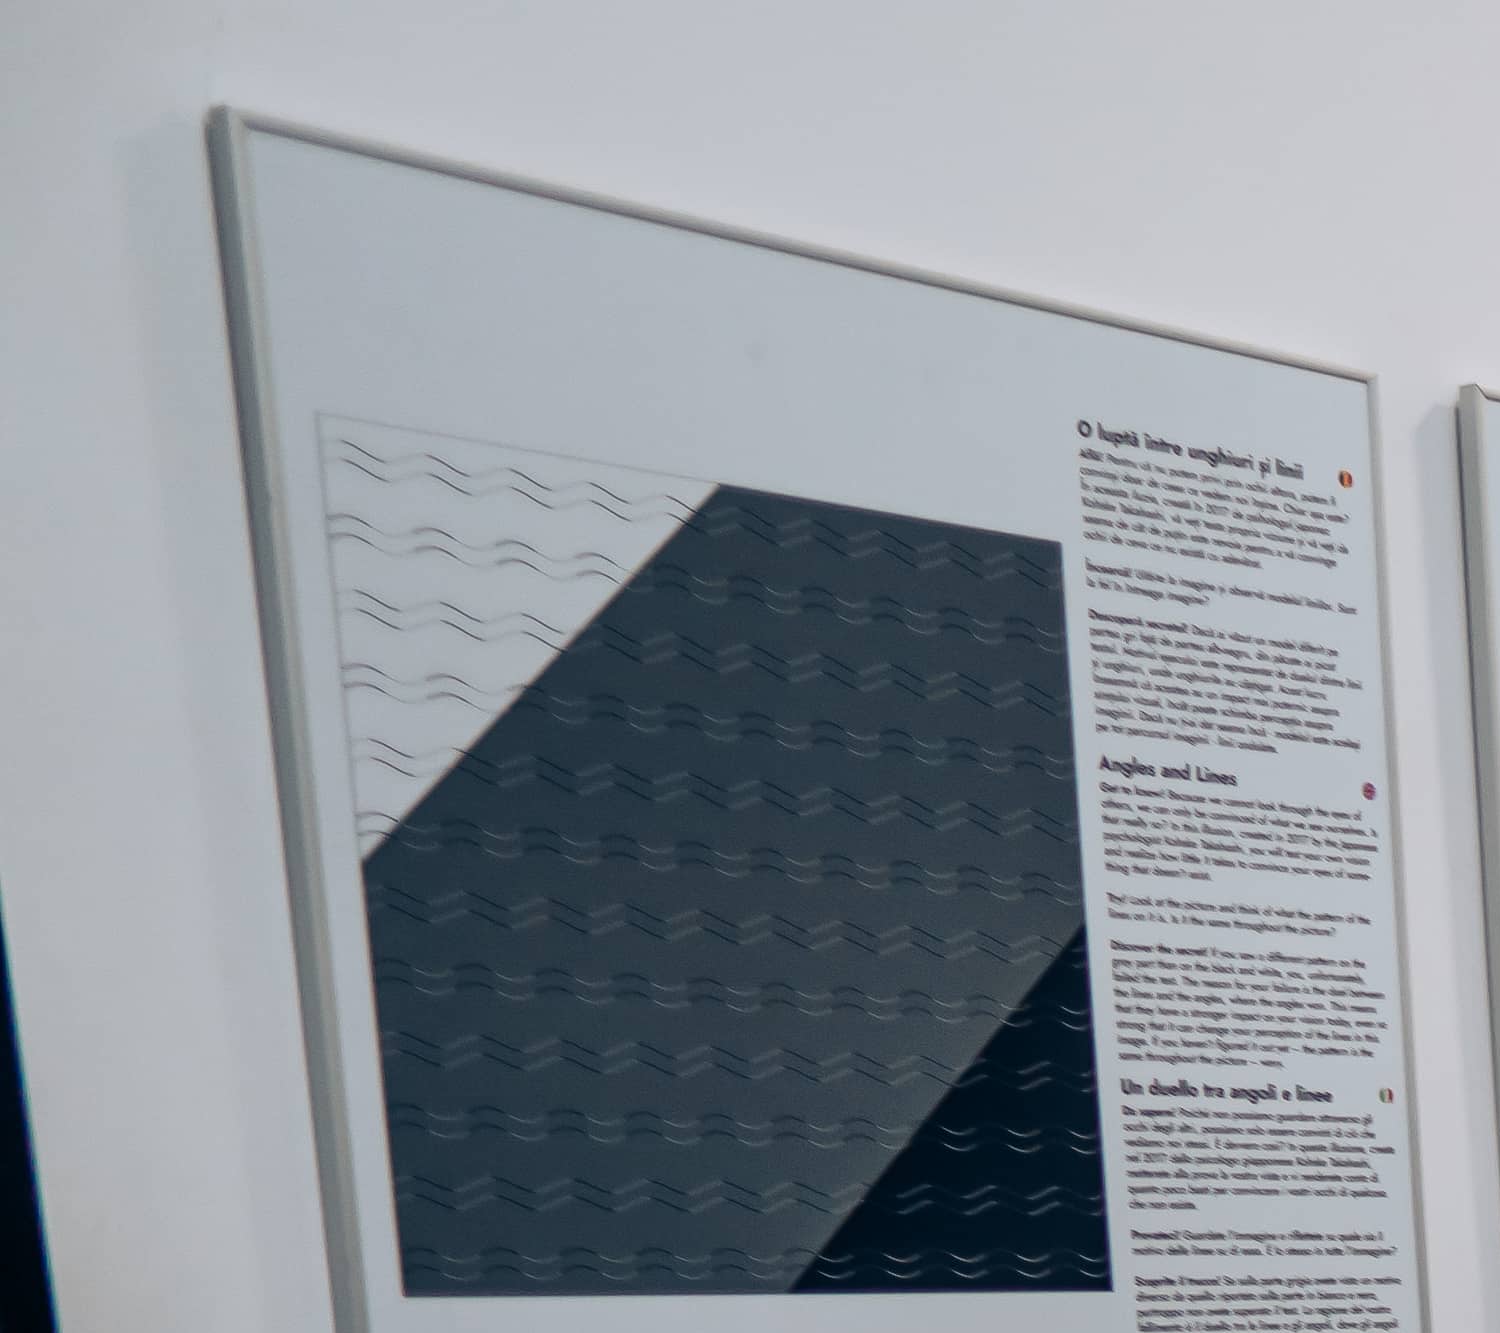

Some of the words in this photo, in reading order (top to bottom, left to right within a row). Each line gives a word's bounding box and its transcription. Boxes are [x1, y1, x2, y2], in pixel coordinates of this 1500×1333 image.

[1077, 419, 1092, 438] O
[1099, 755, 1156, 779] Angles
[1161, 763, 1193, 782] and
[1196, 765, 1238, 787] Lines
[1120, 1078, 1145, 1097] Un
[1149, 1078, 1199, 1097] duello
[1203, 1082, 1225, 1098] tra
[1229, 1083, 1278, 1104] angoli
[1282, 1089, 1292, 1101] e
